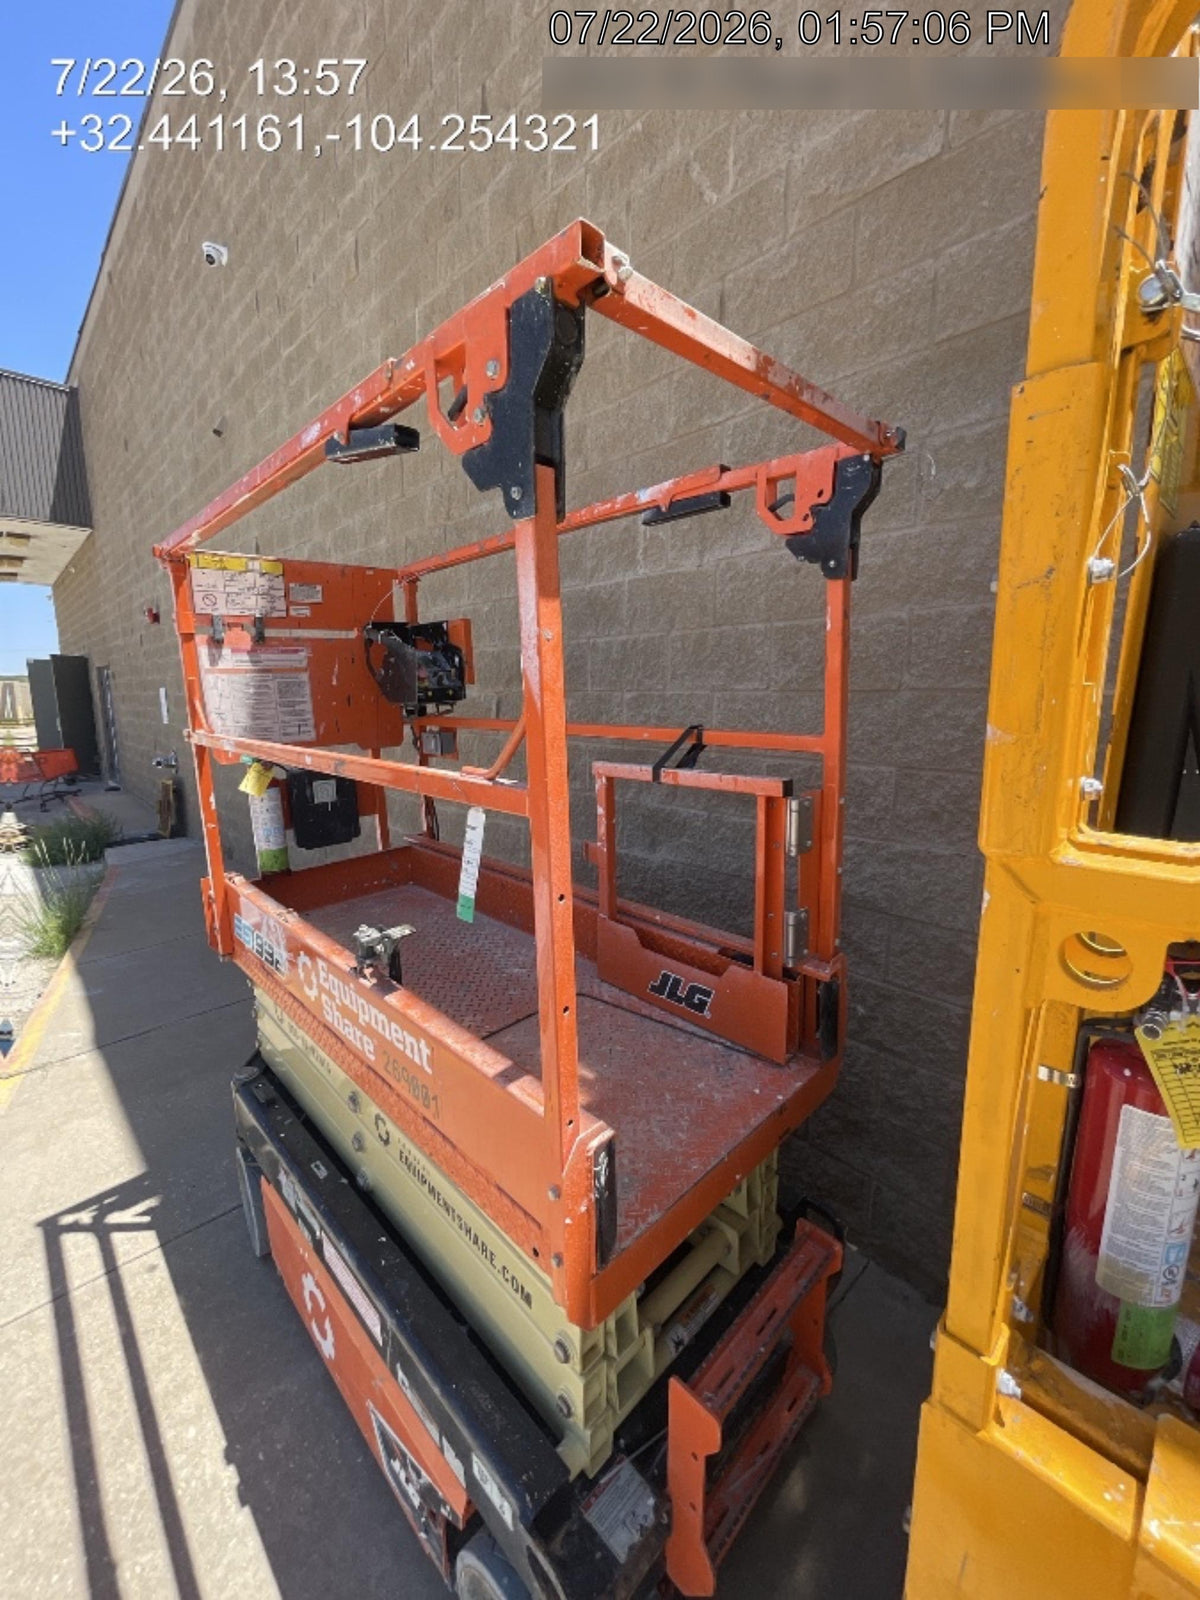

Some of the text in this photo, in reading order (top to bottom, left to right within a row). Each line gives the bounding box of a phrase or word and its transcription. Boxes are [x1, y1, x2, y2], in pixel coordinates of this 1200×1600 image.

[316, 957, 433, 1075] Equipment
[321, 992, 376, 1062] Share
[647, 970, 715, 1016] JLG
[399, 1149, 533, 1310] EQUIPMENTSHARE.COM
